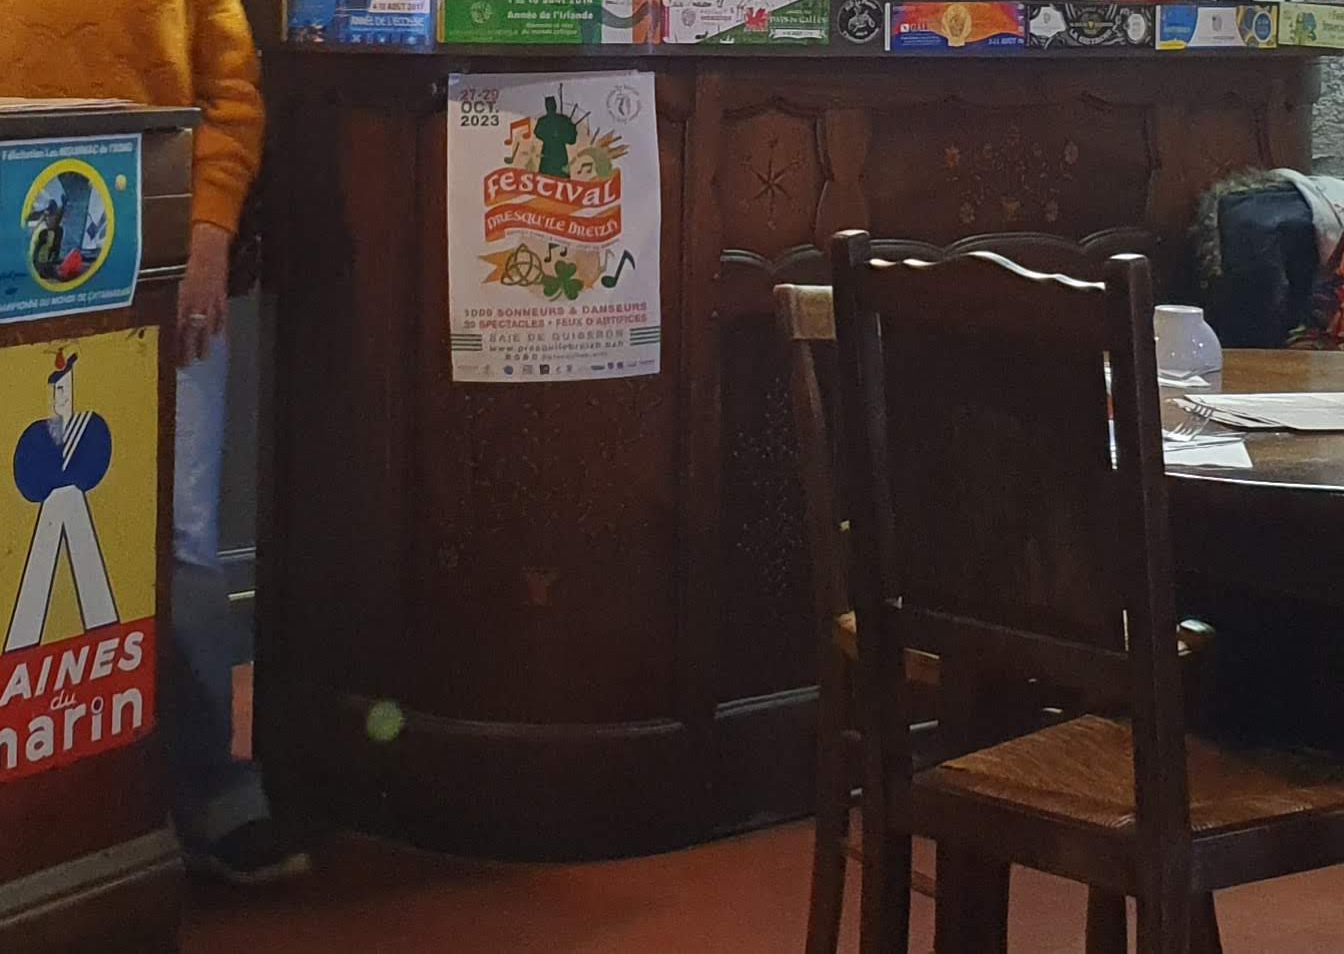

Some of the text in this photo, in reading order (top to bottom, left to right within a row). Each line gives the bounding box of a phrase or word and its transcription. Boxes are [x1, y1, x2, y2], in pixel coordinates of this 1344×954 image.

[460, 88, 499, 101] 27-29
[460, 101, 500, 114] OCT.
[460, 115, 500, 127] 2023
[582, 302, 648, 314] DANSEURS
[479, 319, 545, 329] SPECTACLES
[527, 332, 545, 342] DE
[50, 690, 78, 711] du
